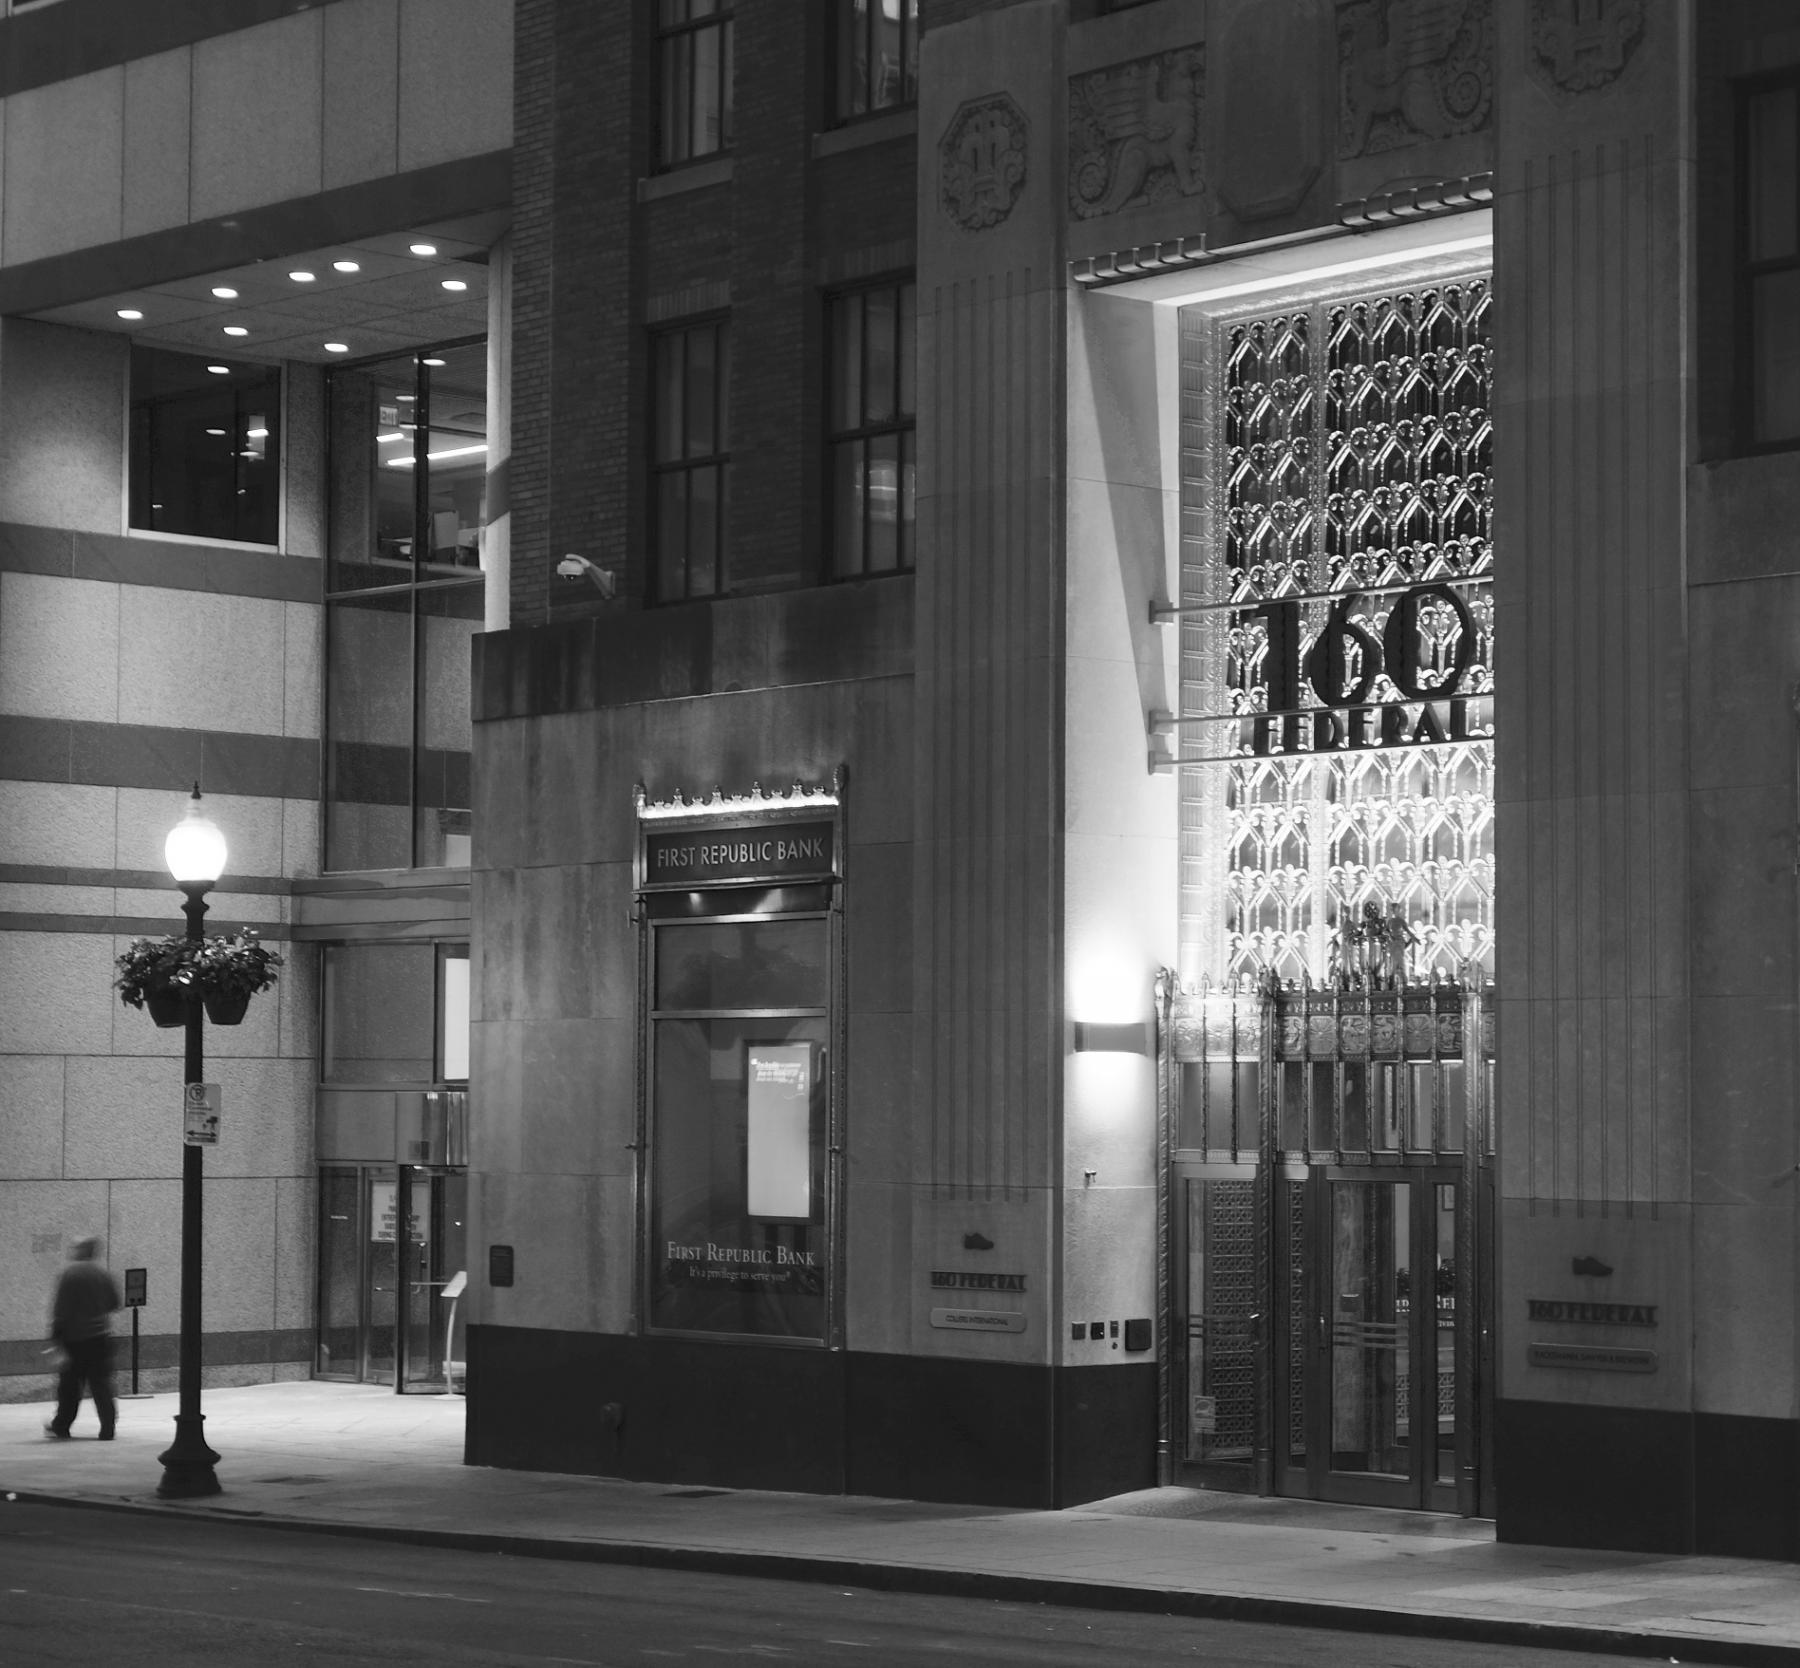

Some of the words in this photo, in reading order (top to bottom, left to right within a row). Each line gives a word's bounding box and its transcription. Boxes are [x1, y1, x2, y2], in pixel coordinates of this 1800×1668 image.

[1254, 584, 1472, 712] 160
[1252, 700, 1482, 757] FEDERAL
[657, 847, 695, 867] FIRST
[701, 841, 772, 865] REPUBLIC
[777, 837, 824, 861] BANK
[667, 1241, 702, 1261] FIRST
[707, 1242, 772, 1265] REPUBLIC
[776, 1245, 816, 1266] BANK
[741, 1271, 750, 1280] to
